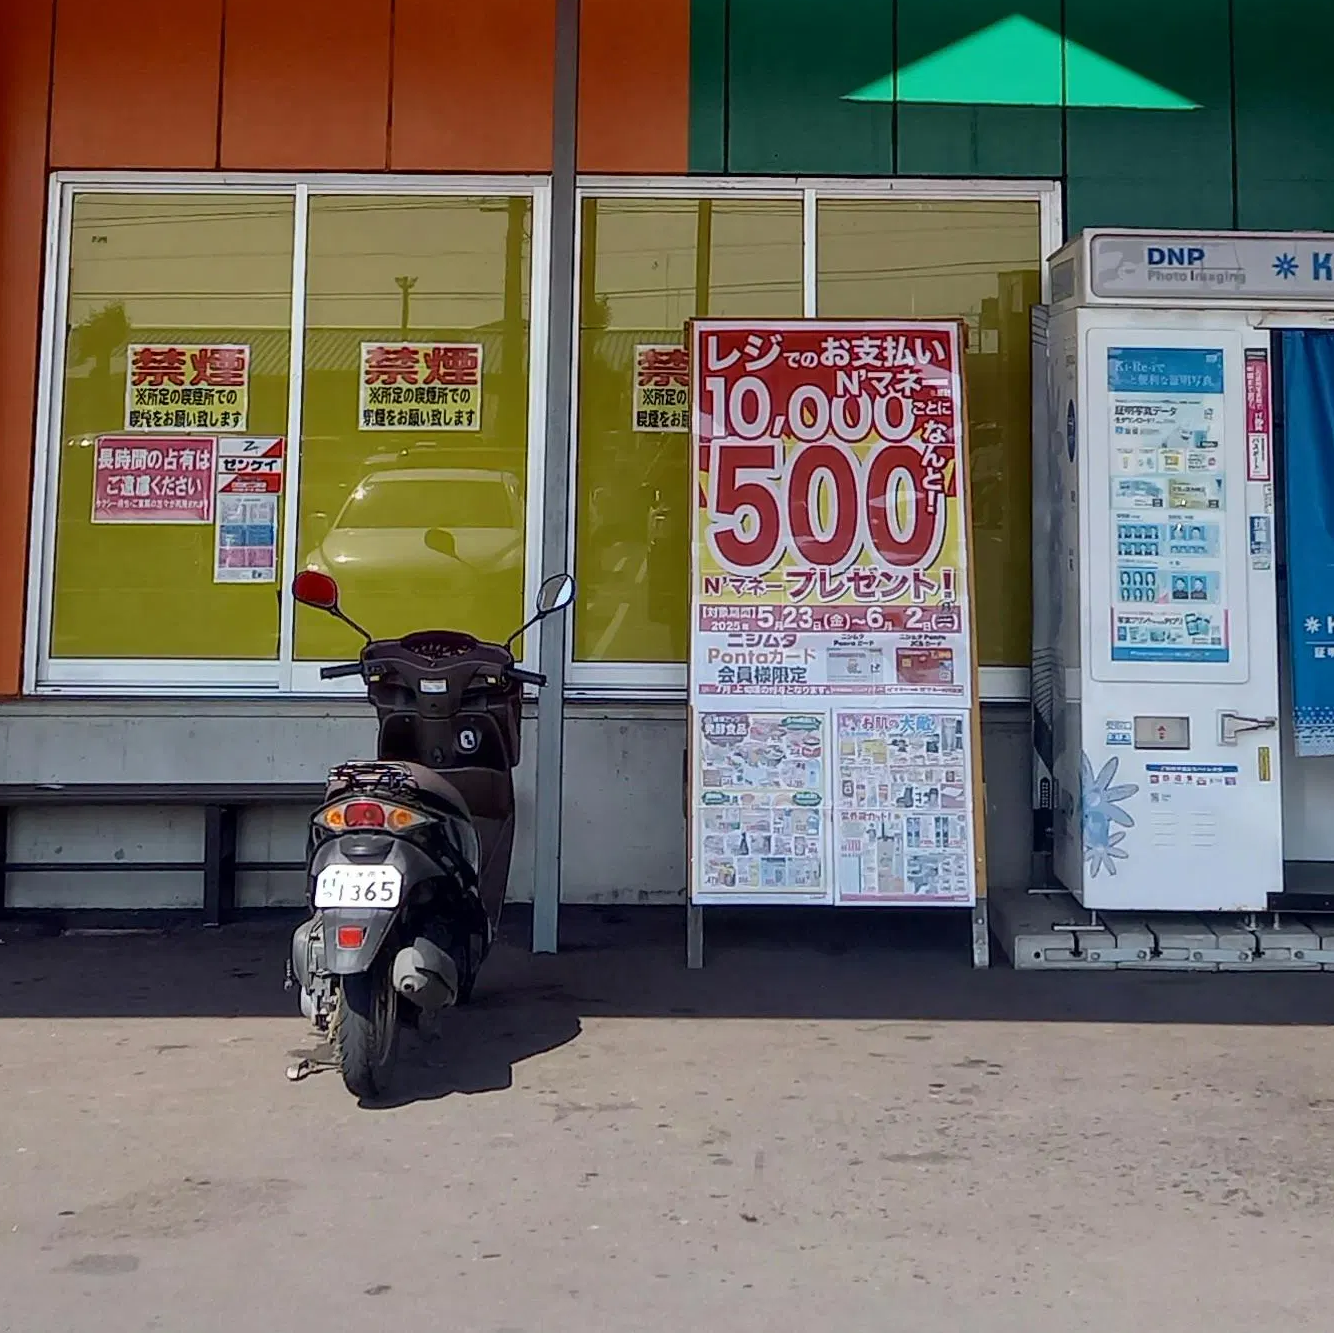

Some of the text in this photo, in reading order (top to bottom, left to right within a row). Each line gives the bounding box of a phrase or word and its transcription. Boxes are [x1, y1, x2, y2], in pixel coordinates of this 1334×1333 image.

[1148, 247, 1204, 265] DNP
[1148, 269, 1246, 285] Photo Imaging
[707, 333, 946, 372] レジでのお支払い
[131, 348, 245, 386] 禁煙
[364, 346, 479, 385] 禁煙
[835, 368, 949, 396] N'マネー
[705, 376, 916, 442] 10,000
[99, 448, 210, 471] 長時間の占有は
[223, 459, 278, 472] ゼンケイ
[921, 419, 948, 513] なんと!
[106, 475, 202, 497] ご遠慮ください
[709, 442, 939, 568] 500
[727, 633, 797, 649] ニシムタ
[707, 649, 816, 665] Pontaカード
[717, 667, 808, 684] 会員様限定
[338, 881, 396, 902] 1365
